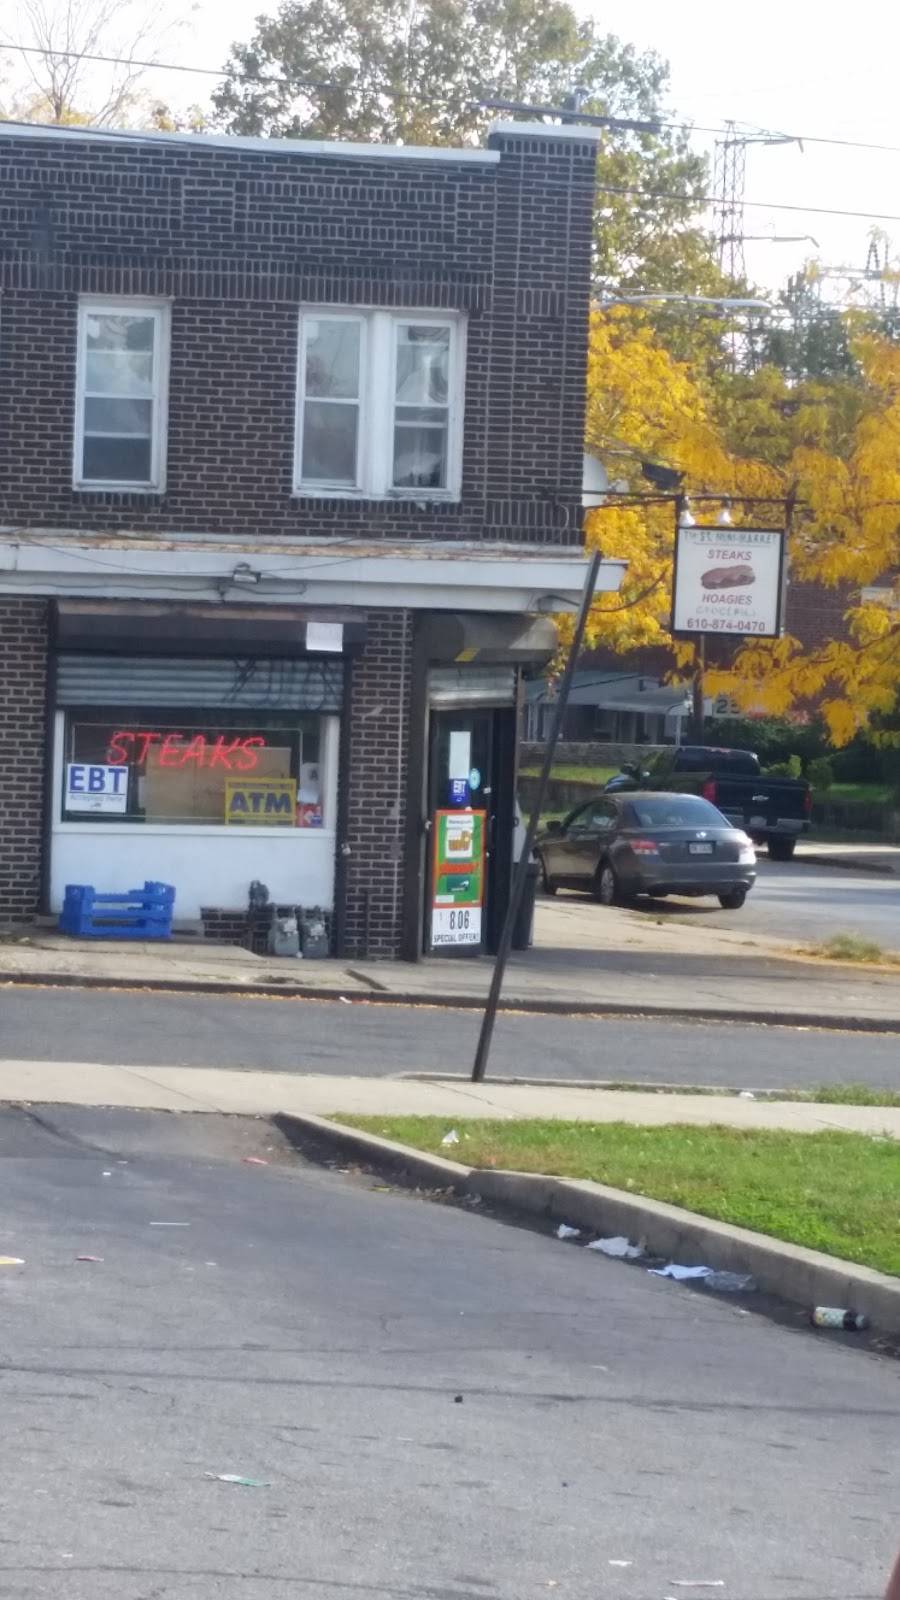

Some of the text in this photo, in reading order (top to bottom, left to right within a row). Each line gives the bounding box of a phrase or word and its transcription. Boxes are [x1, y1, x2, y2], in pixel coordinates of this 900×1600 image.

[706, 549, 752, 561] STEAKS
[702, 593, 752, 606] HOAGIES
[687, 618, 765, 632] 610-874-0470
[106, 731, 265, 769] STEAKS
[69, 766, 127, 793] EBT
[231, 791, 292, 814] ATM
